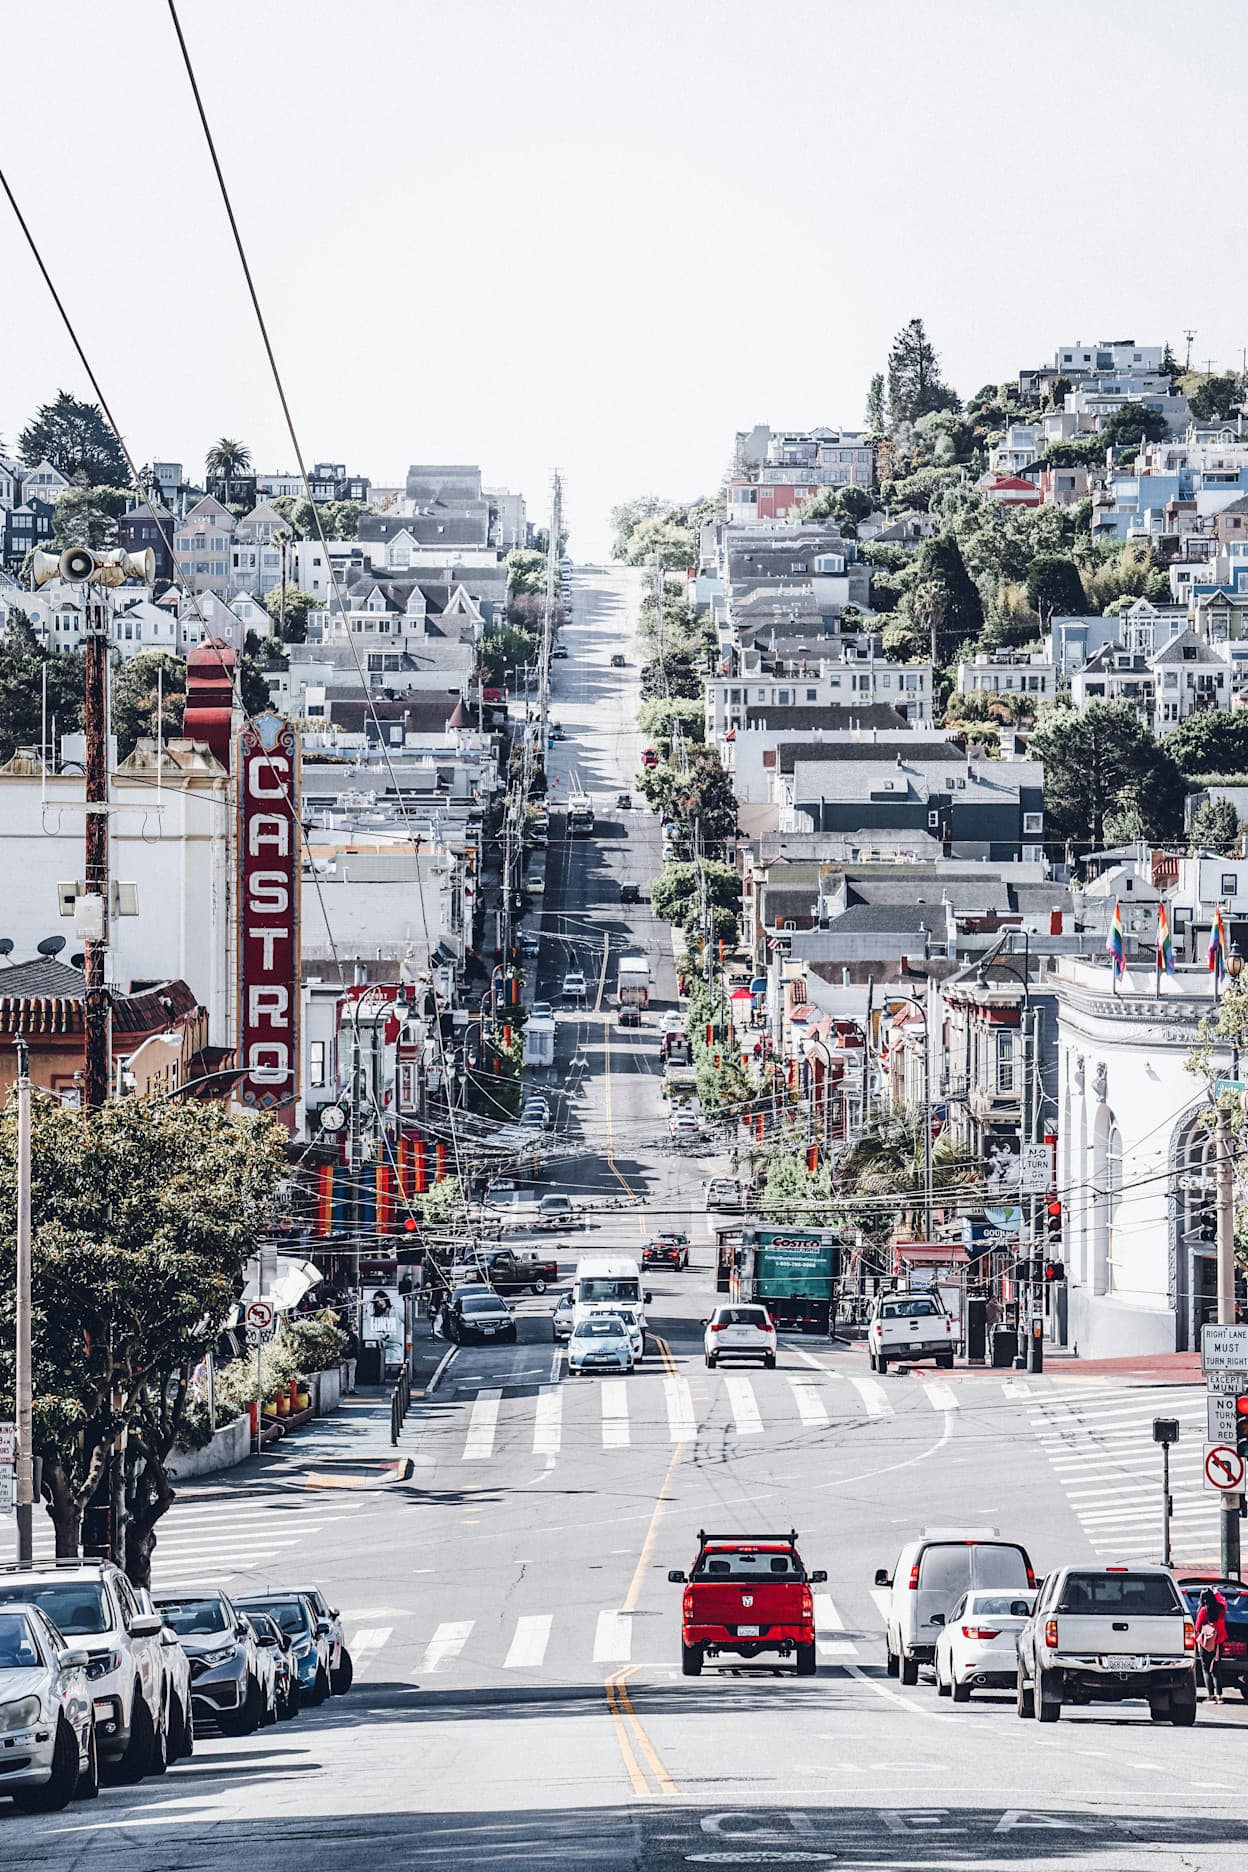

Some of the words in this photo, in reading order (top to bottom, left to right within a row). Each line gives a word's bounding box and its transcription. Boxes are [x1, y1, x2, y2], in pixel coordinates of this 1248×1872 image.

[248, 756, 289, 1085] CASTRO
[1029, 1149, 1047, 1158] NO
[1027, 1160, 1049, 1169] TURN
[1031, 1170, 1044, 1178] ON
[771, 1236, 821, 1248] COSTCO
[1206, 1330, 1226, 1339] RIGHT
[1228, 1331, 1247, 1339] LANE
[1214, 1343, 1239, 1352] MUST
[1206, 1357, 1225, 1365] TURN
[1227, 1357, 1248, 1365] RIGHT
[1213, 1384, 1238, 1392] MUNI
[1216, 1400, 1233, 1409] NO
[1215, 1411, 1236, 1419] TURN
[1217, 1431, 1234, 1439] RED
